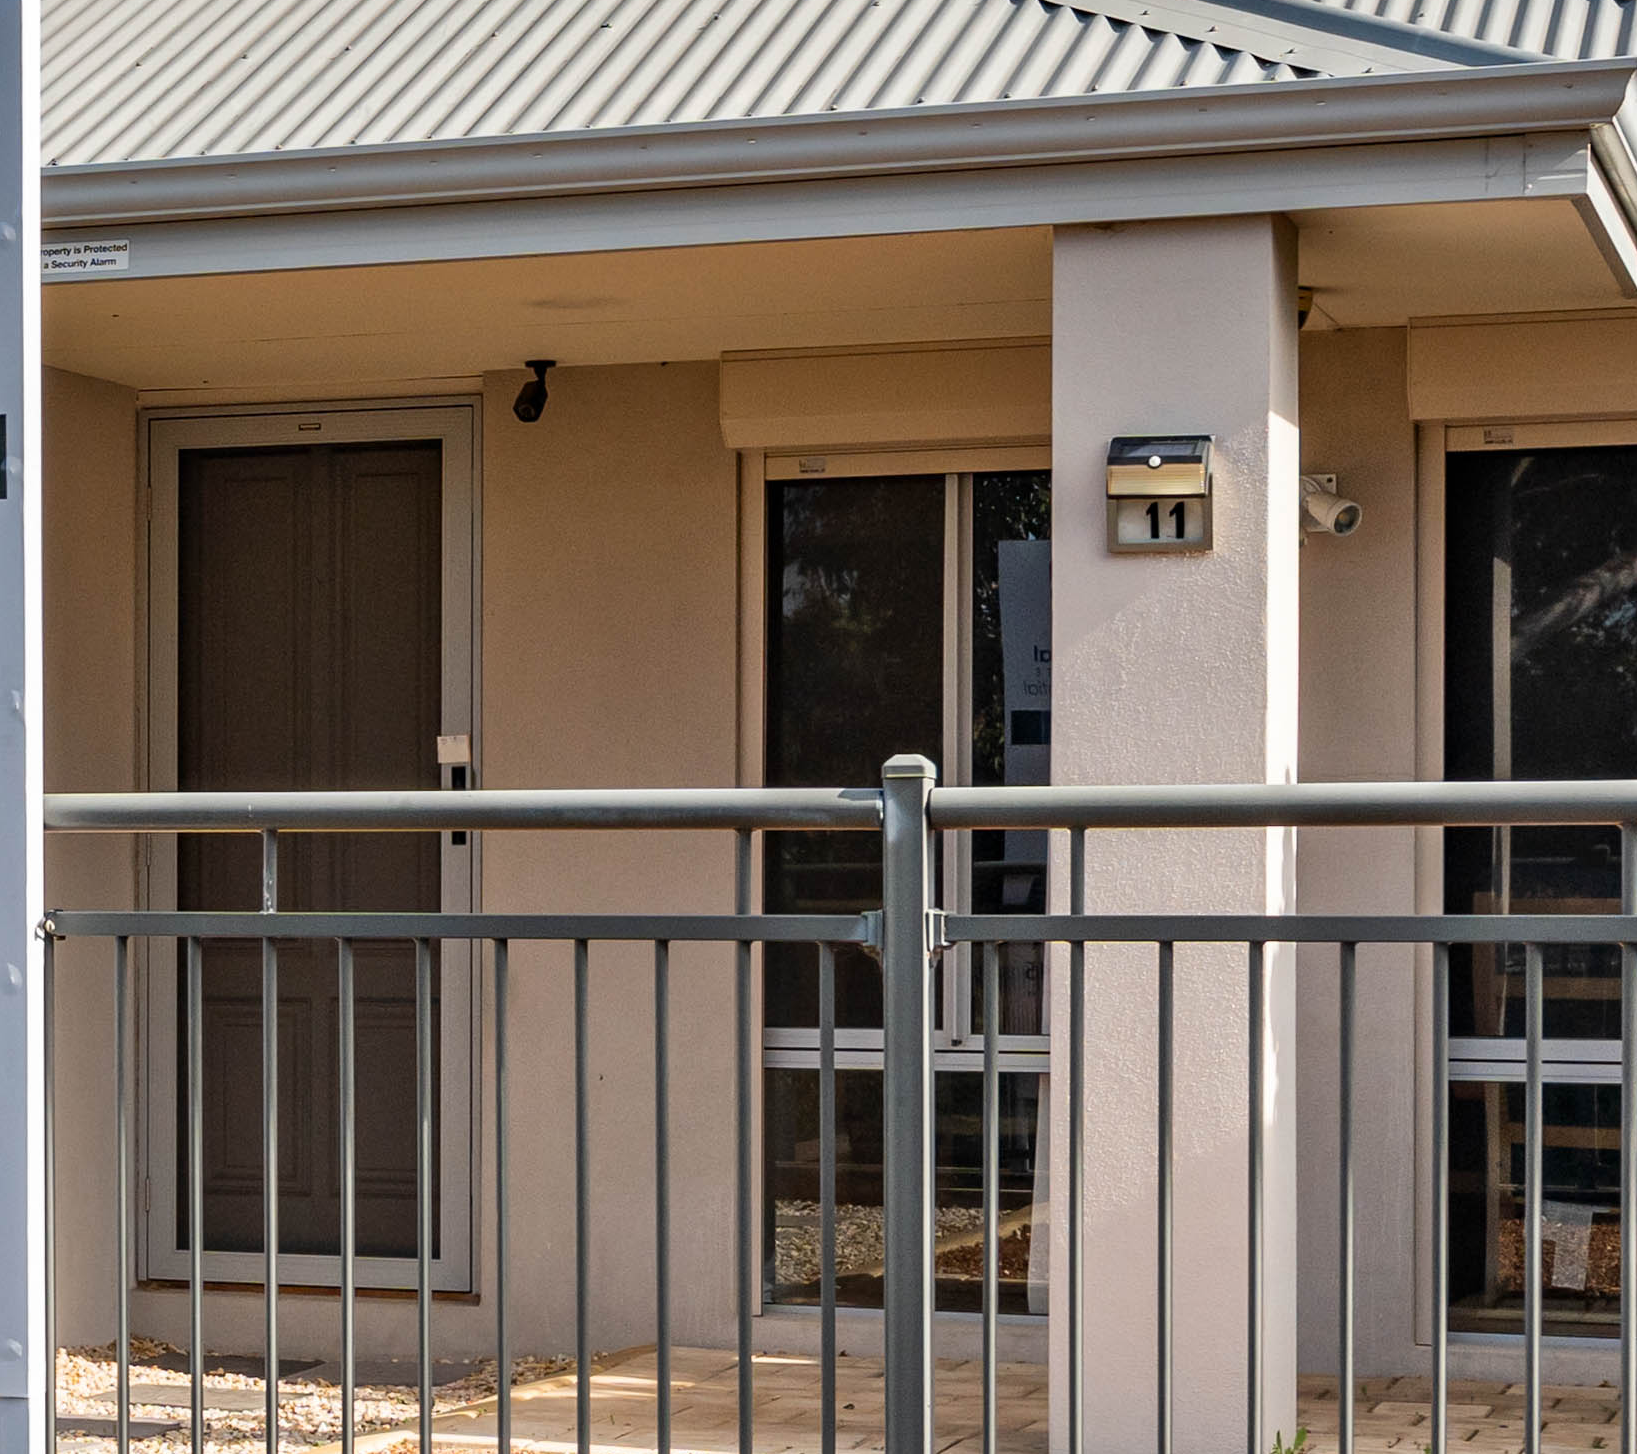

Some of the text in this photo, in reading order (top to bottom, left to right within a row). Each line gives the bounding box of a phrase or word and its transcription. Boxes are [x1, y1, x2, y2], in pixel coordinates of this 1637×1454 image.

[40, 243, 128, 257] roperty is Protected
[50, 259, 88, 269] Security
[90, 258, 117, 267] Alarm
[1145, 501, 1185, 540] 11
